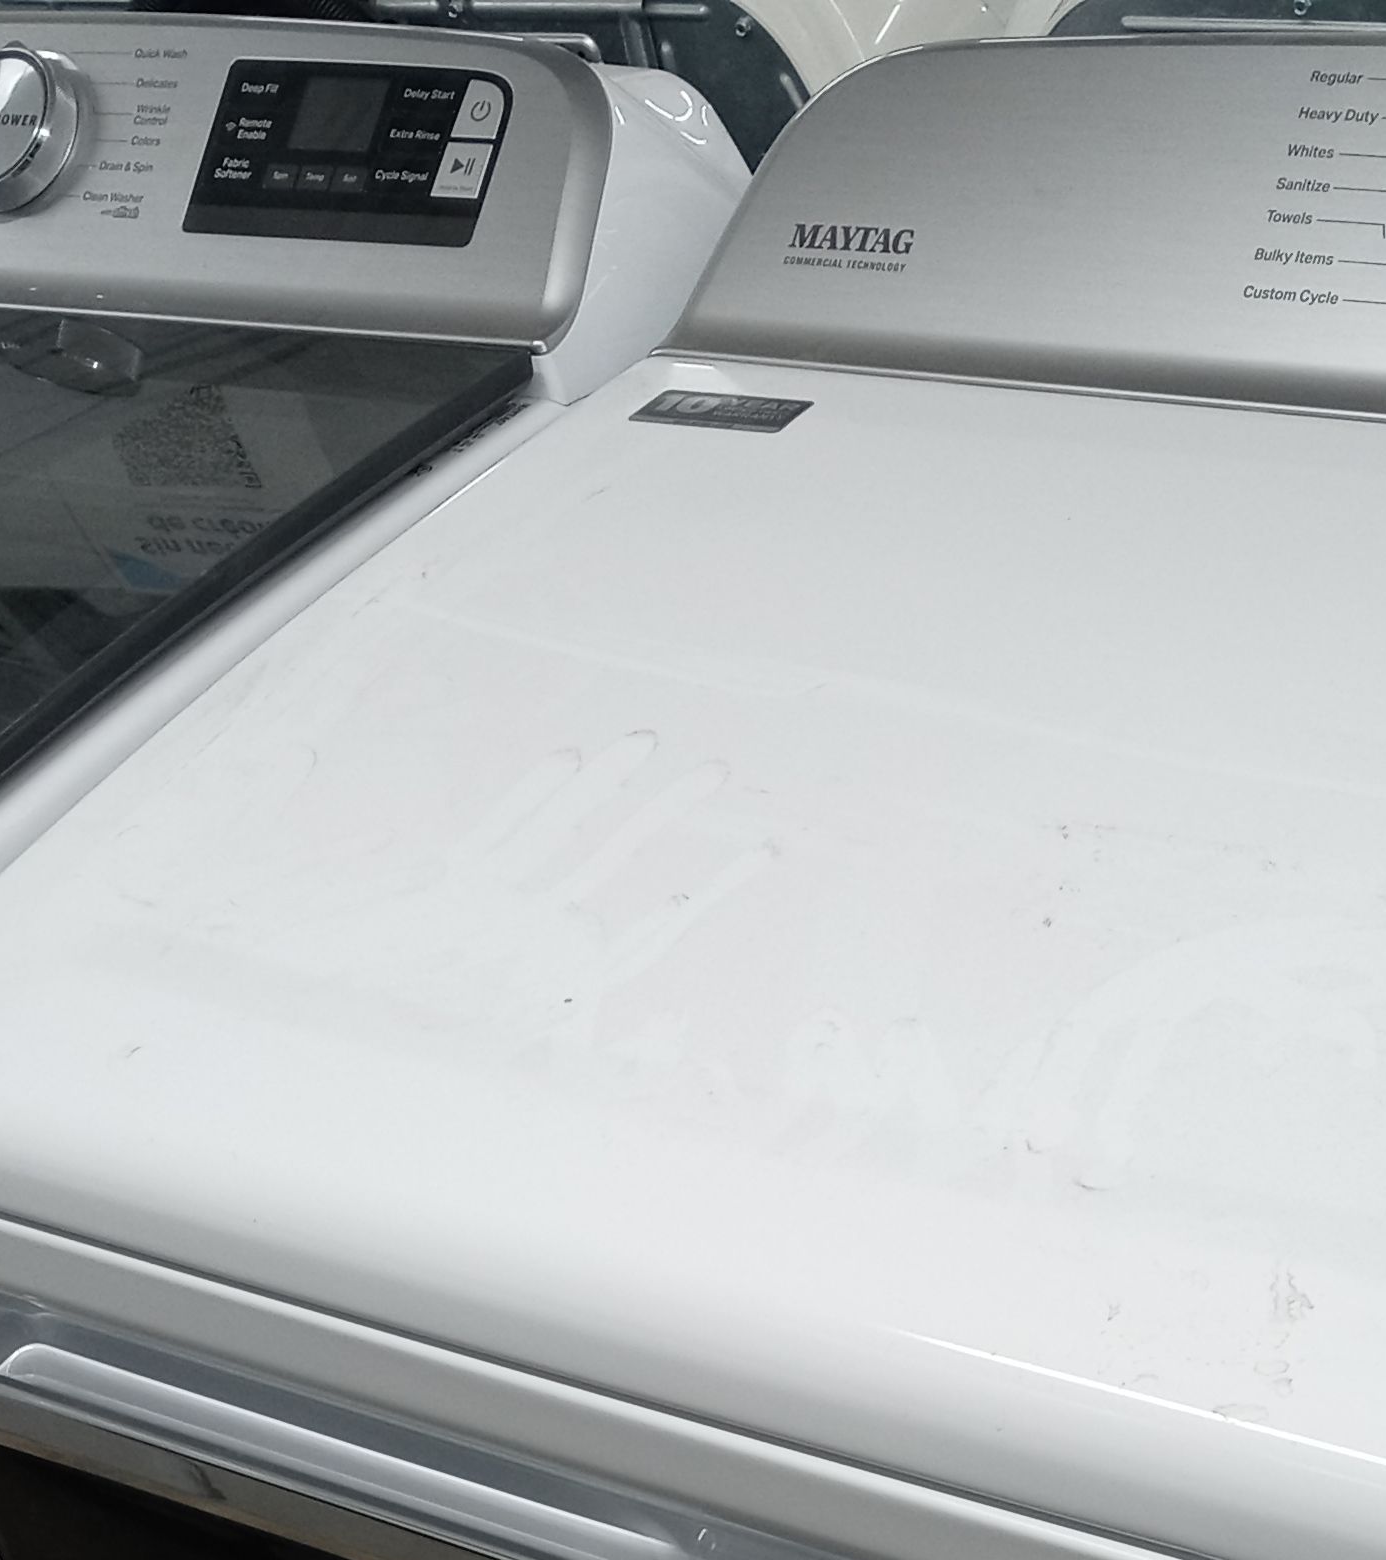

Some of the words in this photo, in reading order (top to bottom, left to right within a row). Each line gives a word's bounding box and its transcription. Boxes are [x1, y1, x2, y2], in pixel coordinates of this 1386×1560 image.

[1310, 70, 1363, 86] Regular
[241, 82, 265, 94] Deep
[265, 83, 279, 94] Fill
[403, 88, 430, 100] Delay
[431, 89, 455, 100] Start
[134, 115, 168, 126] Control
[239, 117, 273, 128] Remote
[1298, 107, 1342, 123] Heavy
[1344, 109, 1379, 125] Duty
[131, 135, 160, 146] Colors
[237, 129, 267, 140] Enable
[389, 129, 414, 139] Extra
[415, 130, 440, 141] Rinse
[1288, 143, 1334, 159] Whites
[99, 161, 123, 171] Drain
[133, 161, 153, 174] Spin
[222, 157, 250, 168] Fabric
[214, 167, 252, 179] Softener
[375, 169, 400, 181] Cycle
[401, 170, 429, 183] Signal
[1276, 178, 1330, 193] Sanitize
[1267, 210, 1313, 225] Towels
[788, 223, 915, 254] MAYTAG
[1254, 248, 1293, 264] Bulky
[1295, 251, 1334, 265] Items
[782, 256, 843, 269] COMMERCIAL
[846, 259, 907, 272] TECHNOLOGY
[1243, 285, 1296, 302] Custom
[1299, 289, 1339, 305] Cycle
[654, 394, 718, 414] 10
